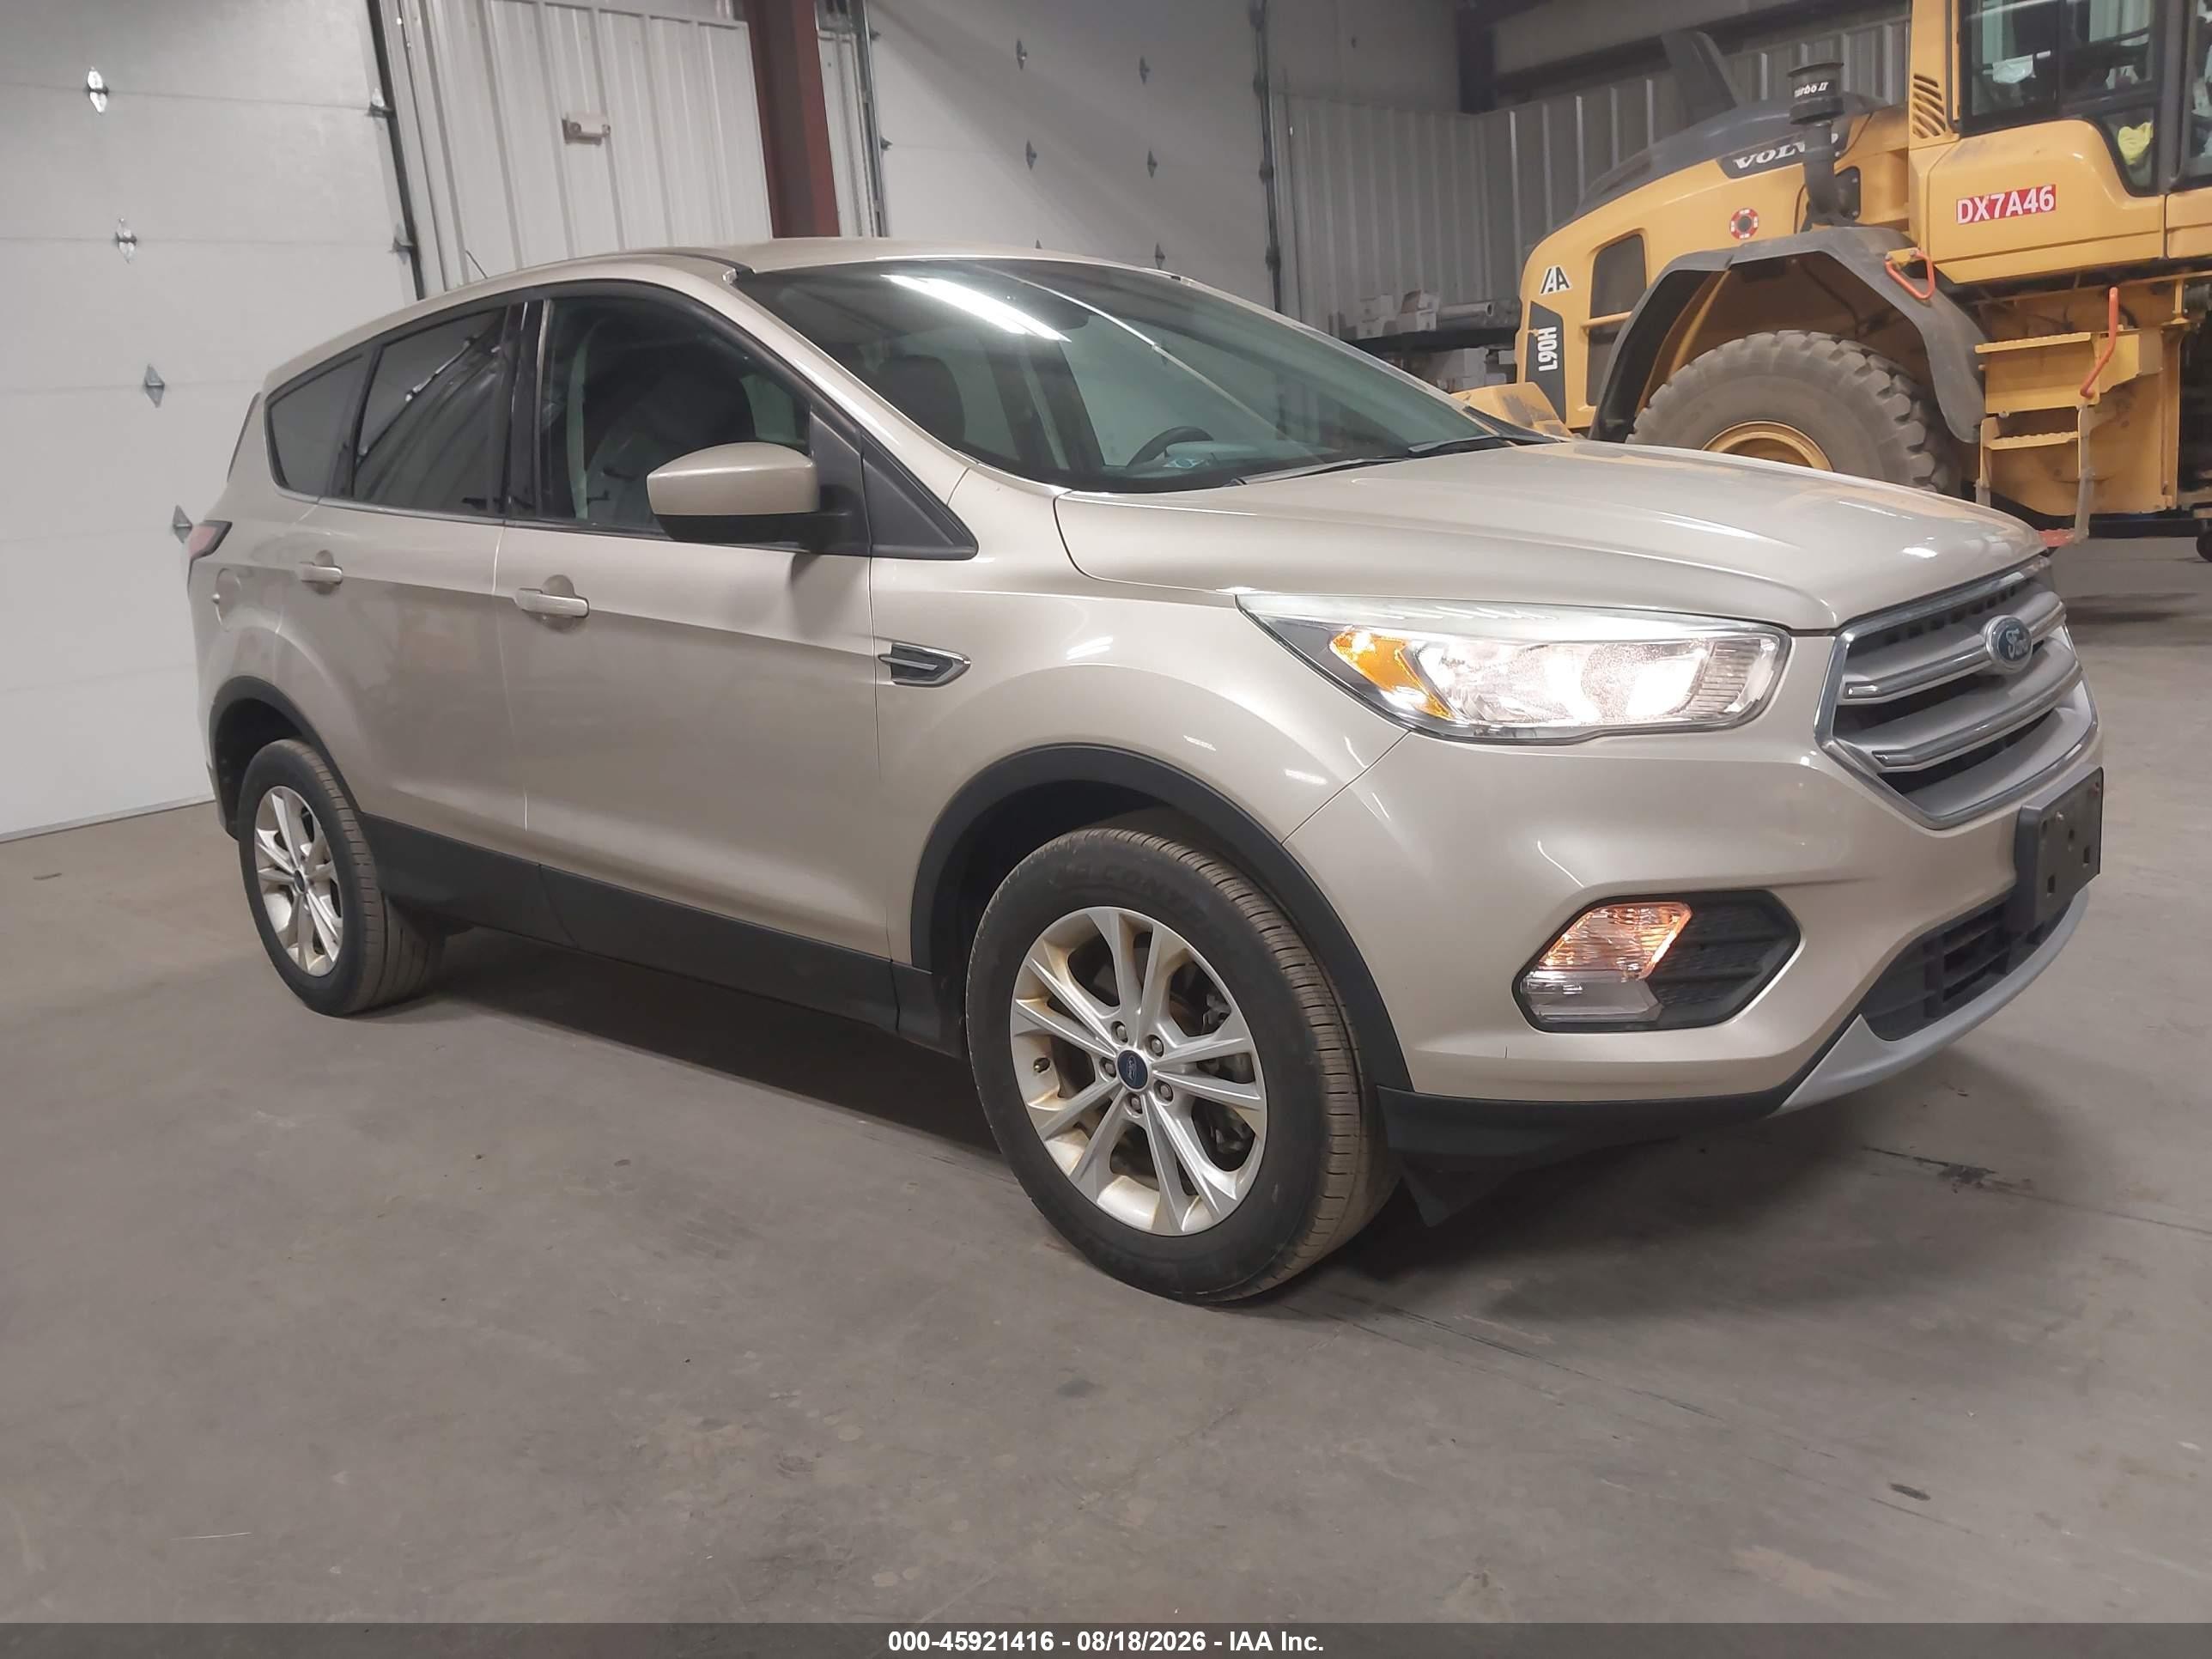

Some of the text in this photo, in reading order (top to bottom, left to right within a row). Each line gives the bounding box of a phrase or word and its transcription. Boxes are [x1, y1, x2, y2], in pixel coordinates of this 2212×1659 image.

[1733, 133, 1838, 169] VOLV
[1957, 185, 2055, 224] DX7A46
[1537, 326, 1559, 372] L90H
